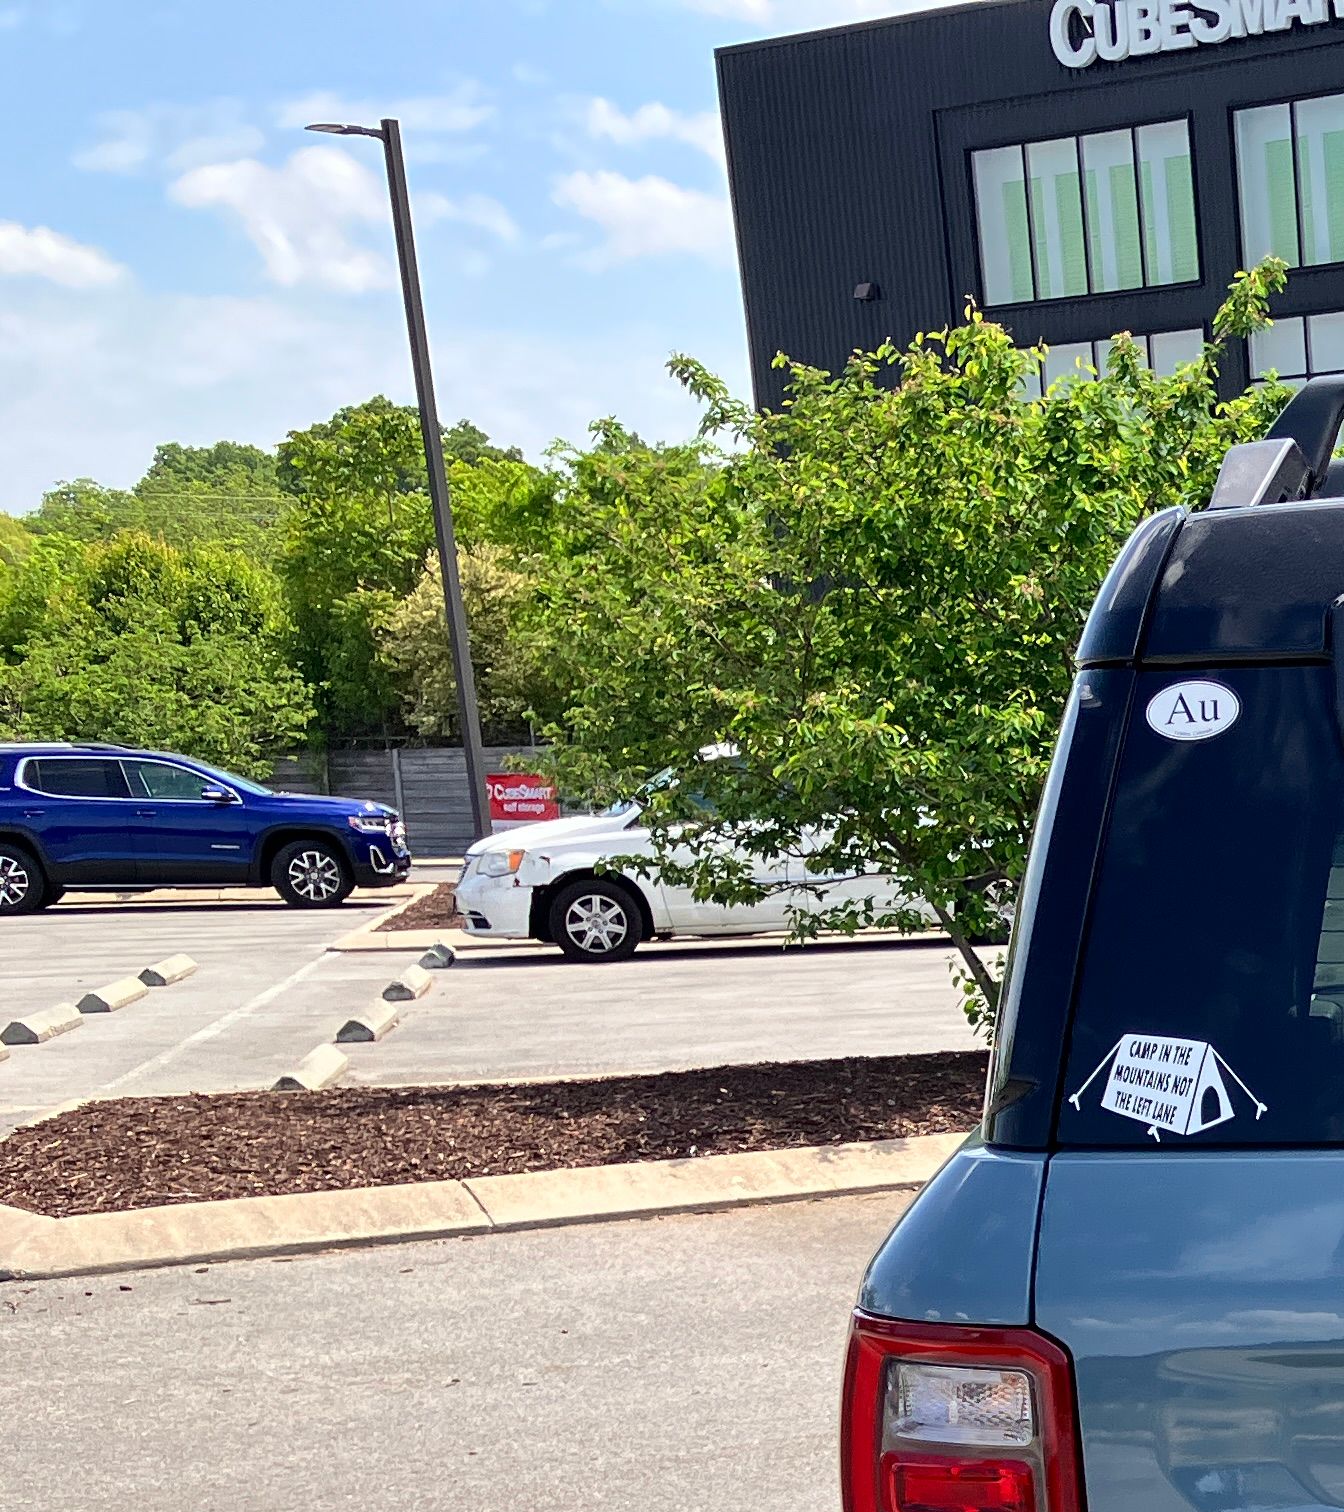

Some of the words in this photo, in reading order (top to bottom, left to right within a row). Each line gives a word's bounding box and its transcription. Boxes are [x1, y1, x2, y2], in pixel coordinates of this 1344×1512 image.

[1164, 692, 1221, 725] Au
[1129, 1040, 1158, 1061] CAMP
[1158, 1043, 1172, 1063] IN
[1172, 1045, 1193, 1066] THE
[1113, 1064, 1170, 1093] MOUNTAINS
[1171, 1076, 1194, 1098] NOT
[1114, 1090, 1132, 1112] THE
[1132, 1096, 1152, 1117] LEFT
[1151, 1100, 1178, 1126] LANE
